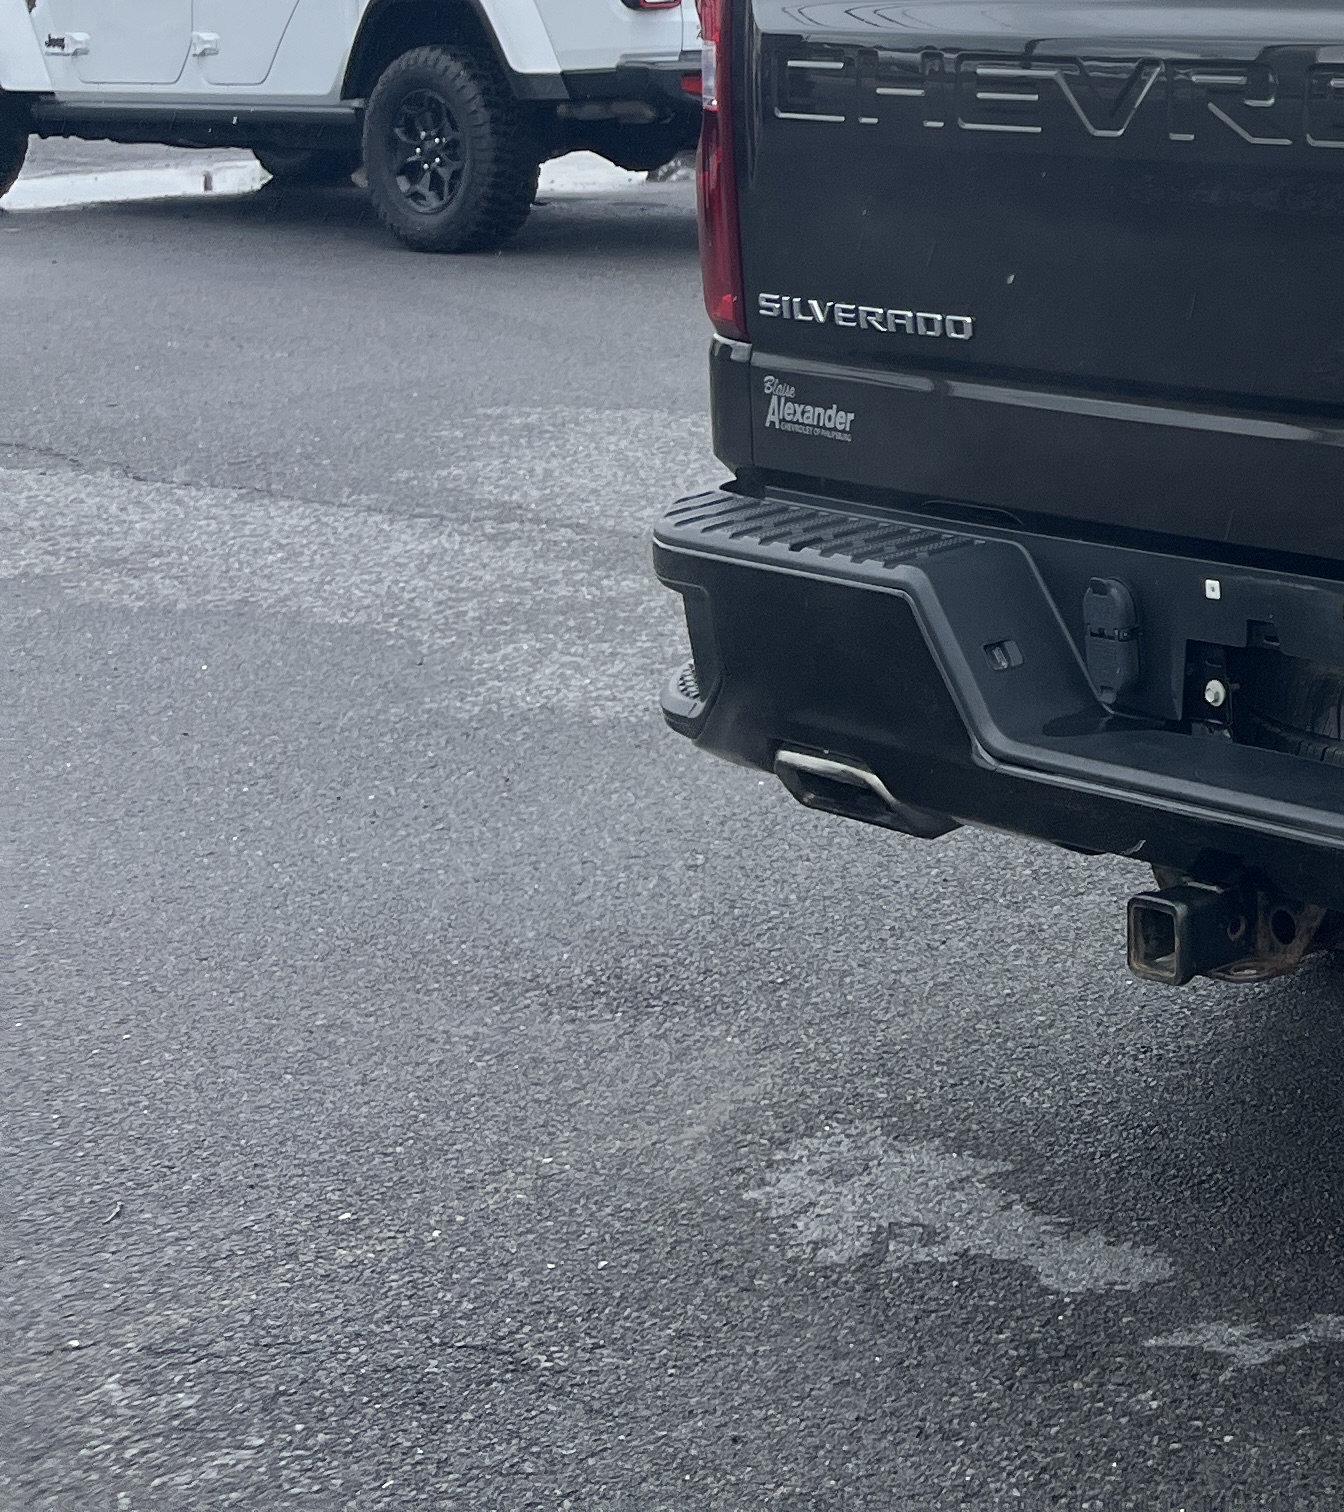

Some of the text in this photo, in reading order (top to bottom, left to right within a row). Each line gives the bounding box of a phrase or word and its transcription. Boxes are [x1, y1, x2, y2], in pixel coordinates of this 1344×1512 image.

[758, 293, 974, 340] SILVERADO
[763, 375, 796, 398] Blaise
[764, 395, 855, 431] Alexander
